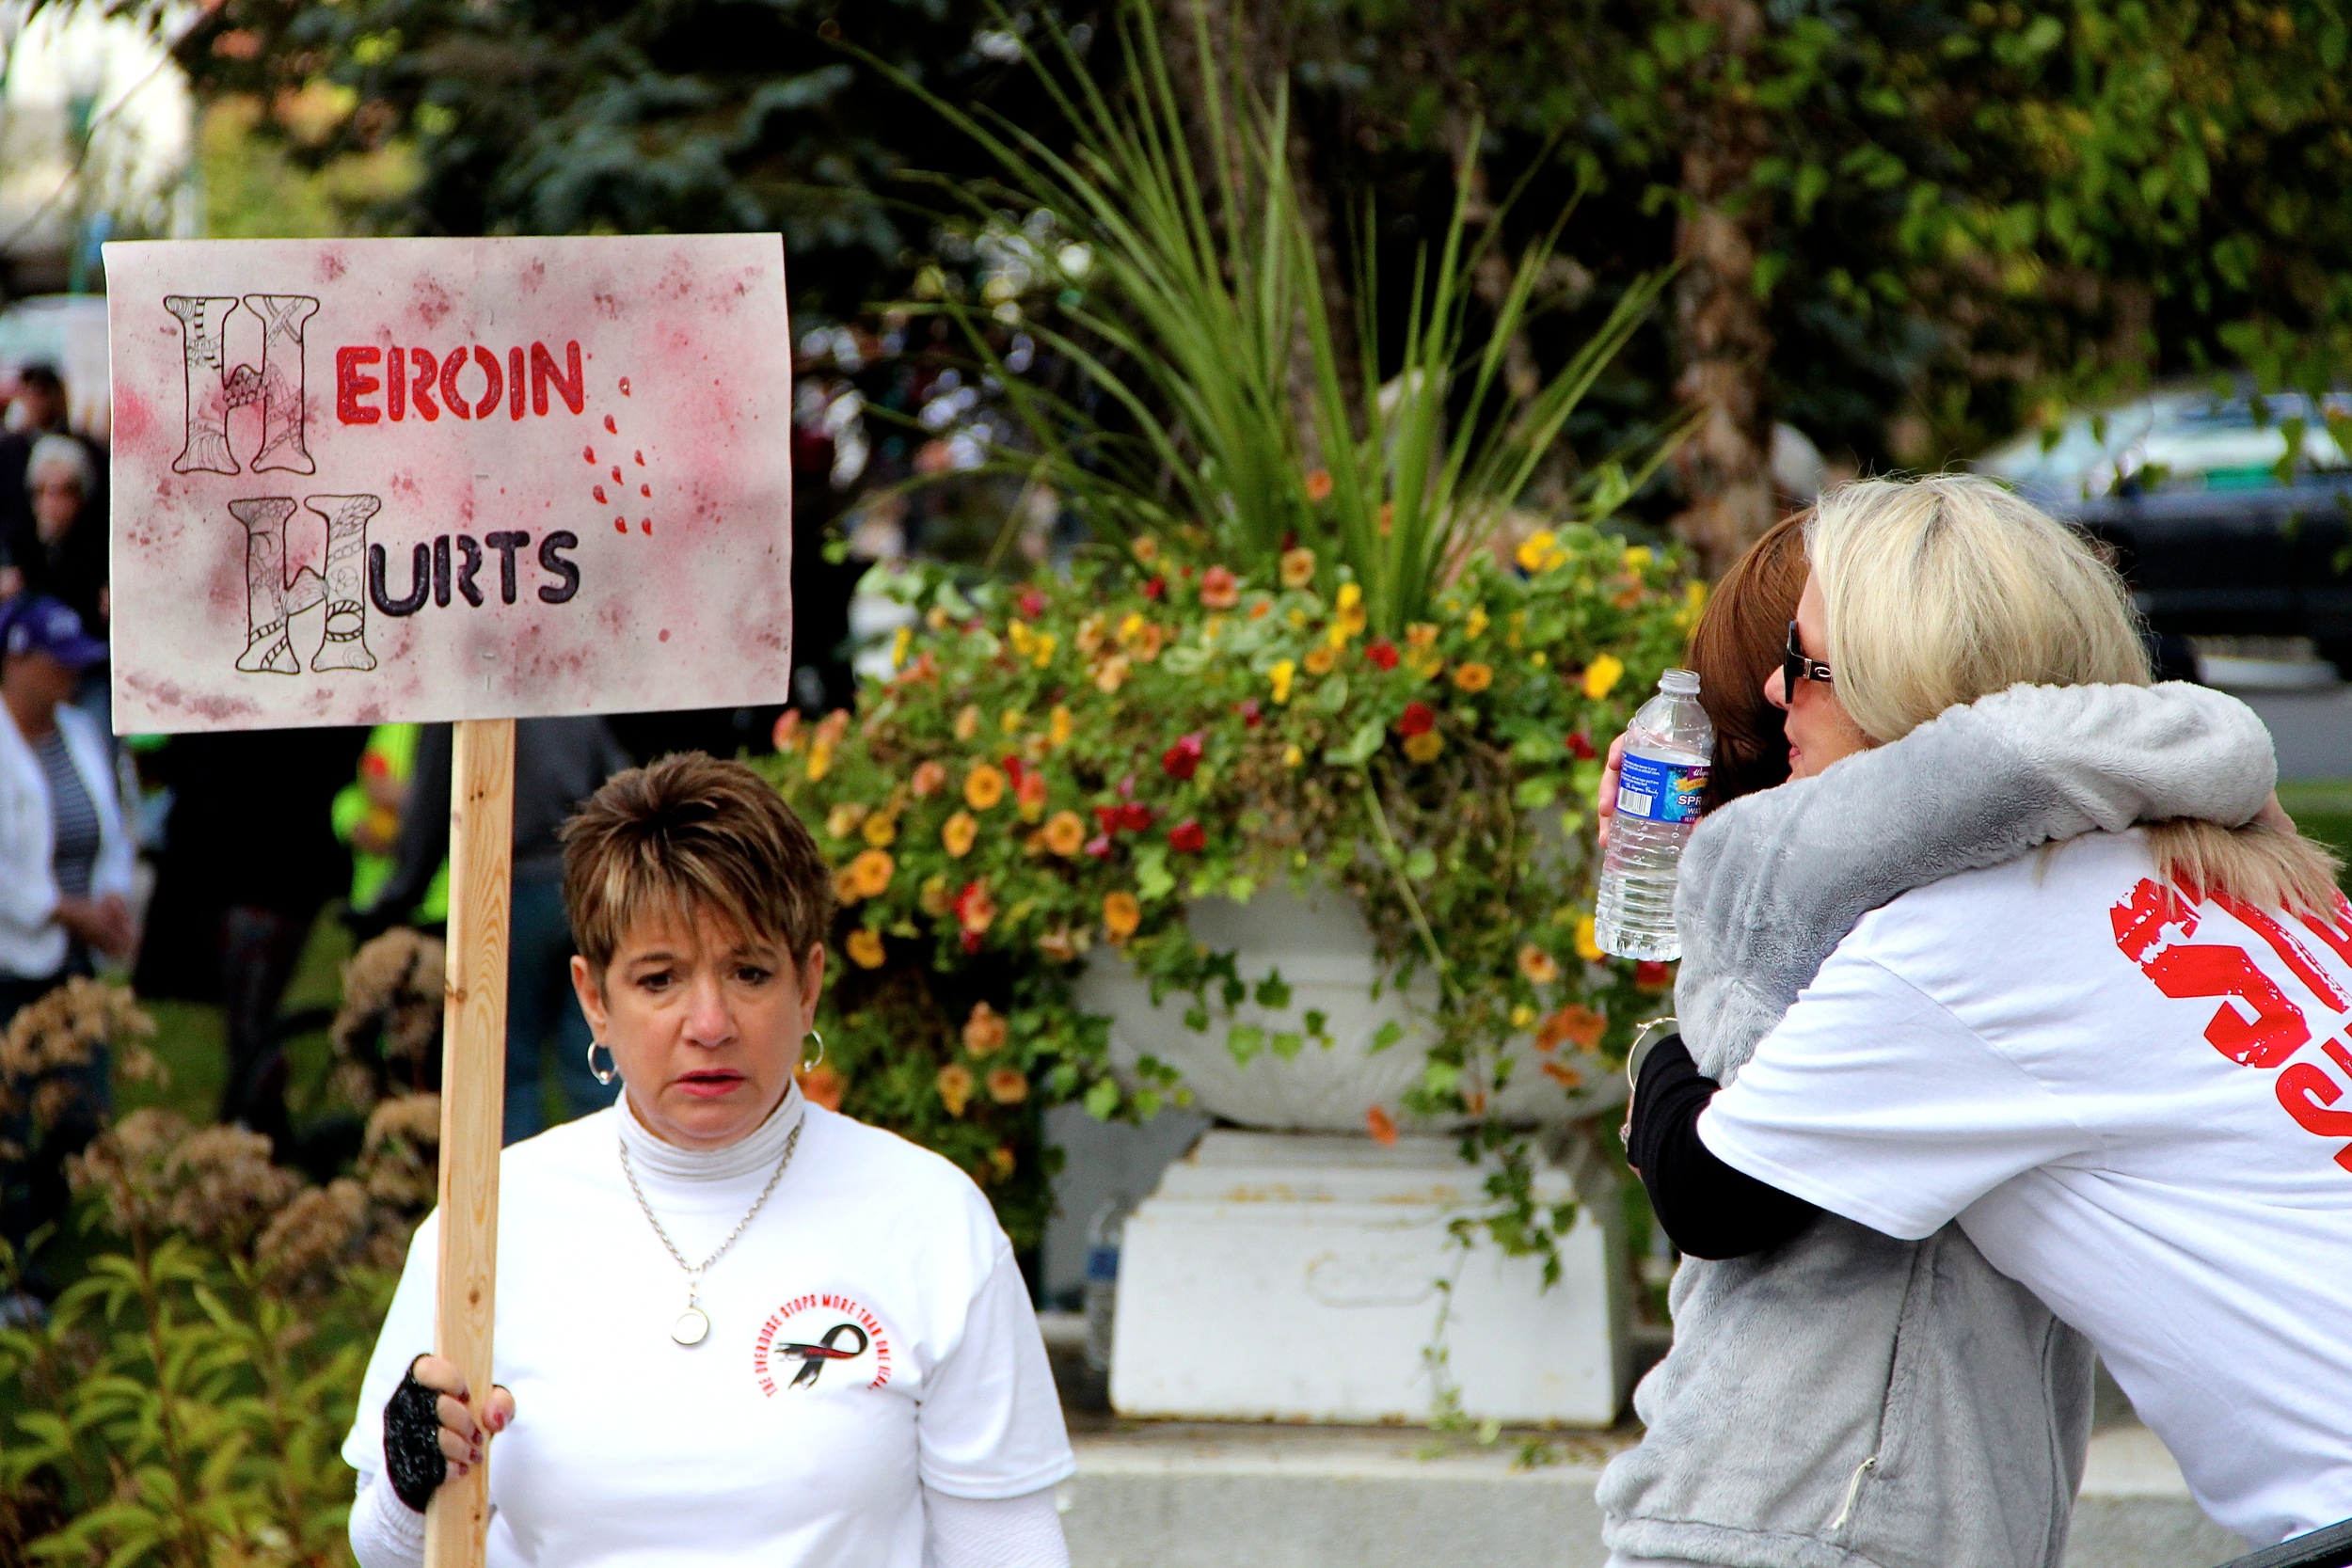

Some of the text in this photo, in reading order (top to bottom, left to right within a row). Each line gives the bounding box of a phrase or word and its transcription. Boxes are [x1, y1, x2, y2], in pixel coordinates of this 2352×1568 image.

[164, 294, 585, 475] HEROIN
[228, 495, 580, 674] HURTS
[1677, 795, 1702, 806] SPR
[780, 1294, 817, 1318] STOPS
[821, 1294, 856, 1315] MORE
[857, 1307, 883, 1338] THAN
[754, 1315, 783, 1374] OVERDOSE
[876, 1340, 891, 1361] ONE
[758, 1377, 778, 1399] THE
